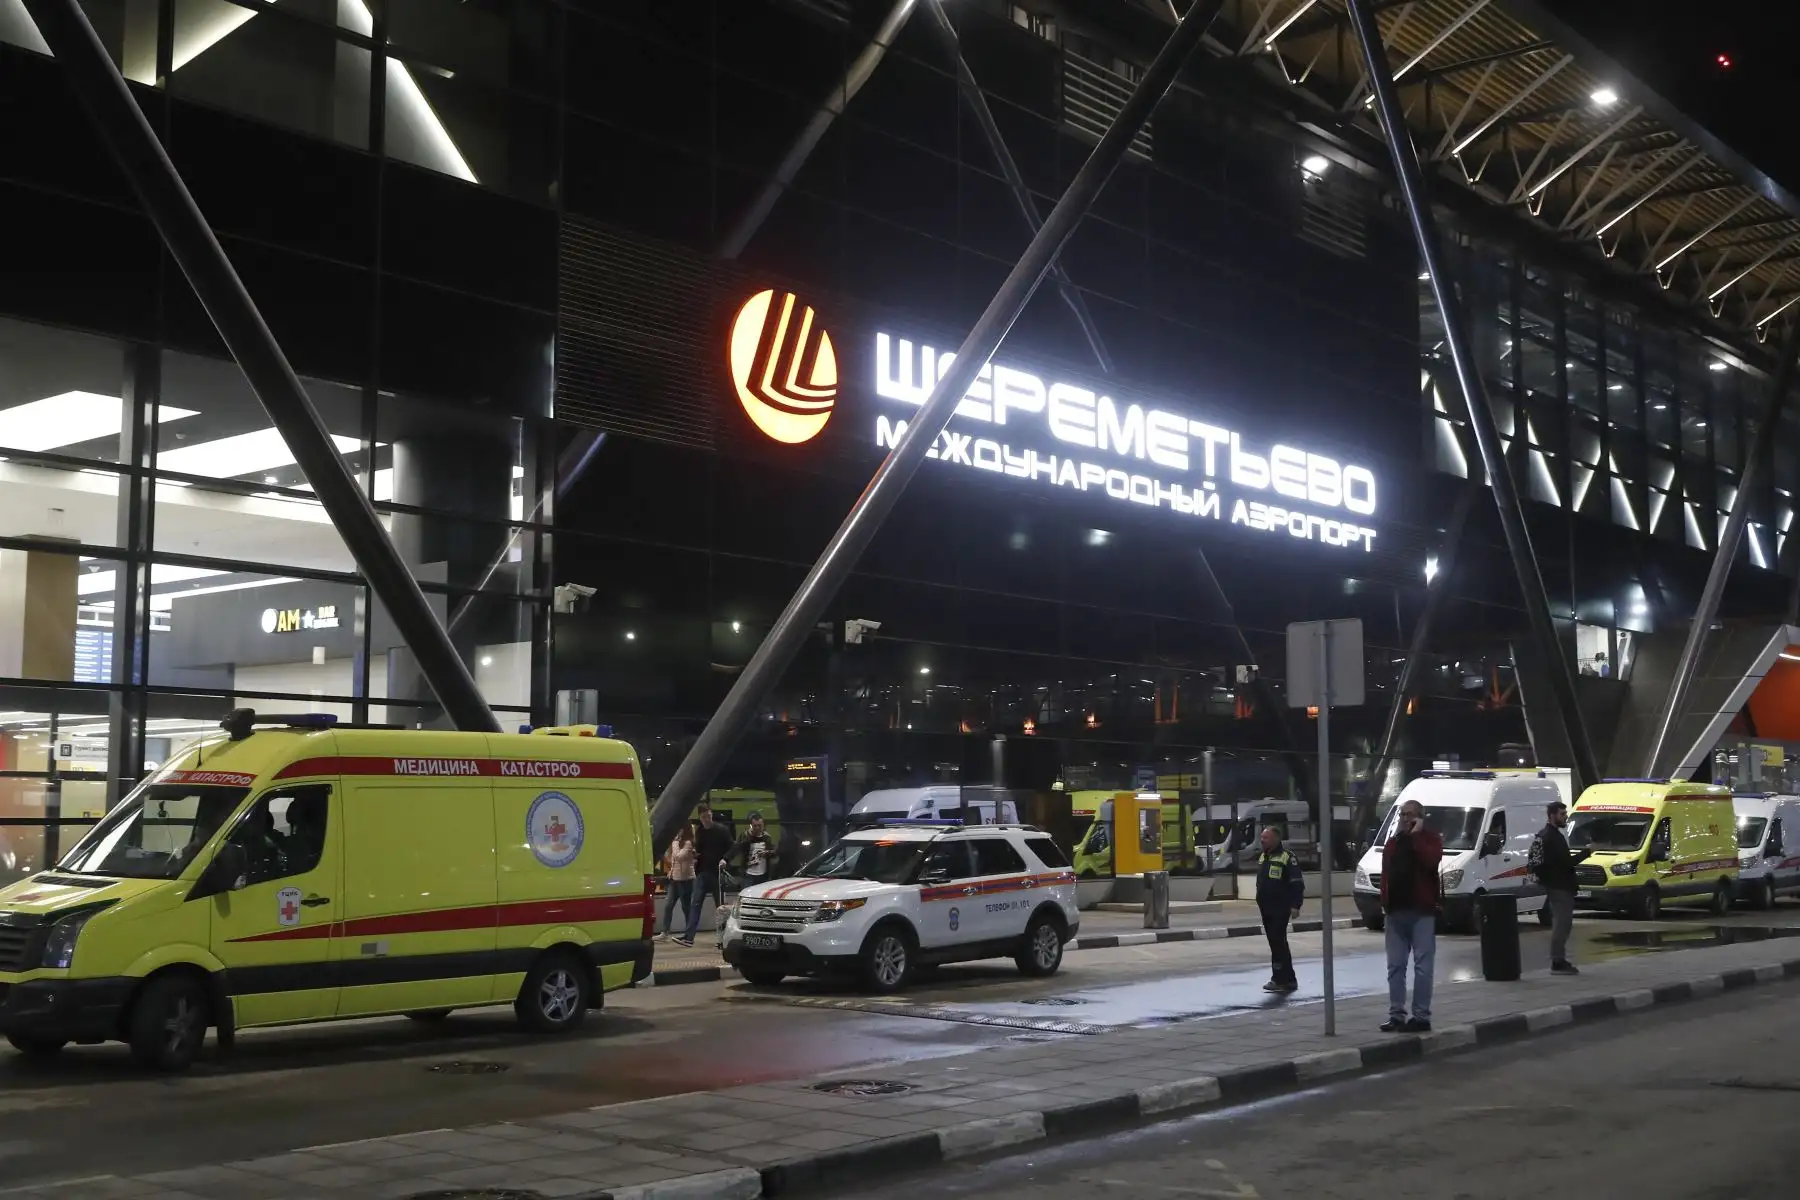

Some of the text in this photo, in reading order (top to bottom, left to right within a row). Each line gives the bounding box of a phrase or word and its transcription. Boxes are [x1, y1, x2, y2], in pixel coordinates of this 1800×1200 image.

[876, 332, 1376, 515] ШЕРЕМЕТЬЕВО
[1231, 499, 1377, 553] АЭРОПОРТ
[189, 772, 252, 785] КАТАСТРОФ
[393, 759, 581, 777] МЕДИЦИНА КАТАСТРОФ
